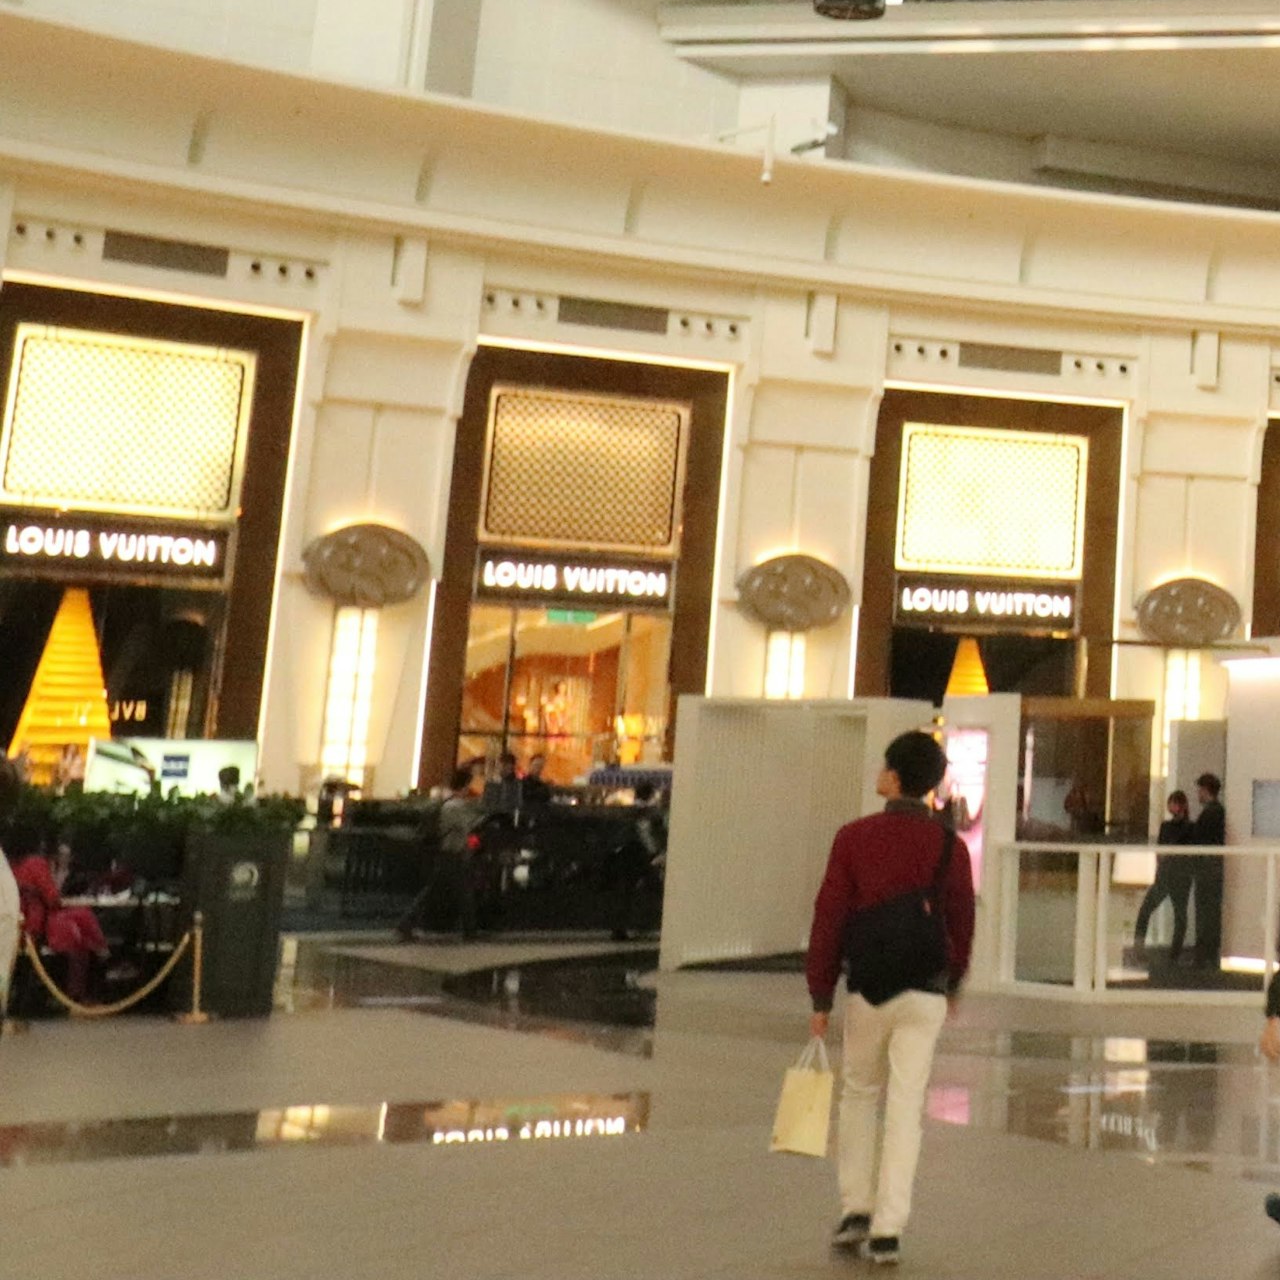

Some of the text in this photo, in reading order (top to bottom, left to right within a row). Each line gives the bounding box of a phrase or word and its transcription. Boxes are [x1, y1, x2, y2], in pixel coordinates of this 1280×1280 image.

[6, 525, 216, 566] LOUIS VUITTON
[483, 561, 667, 596] LOUIS VUITTON
[902, 587, 1071, 618] LOUIS VUITTON
